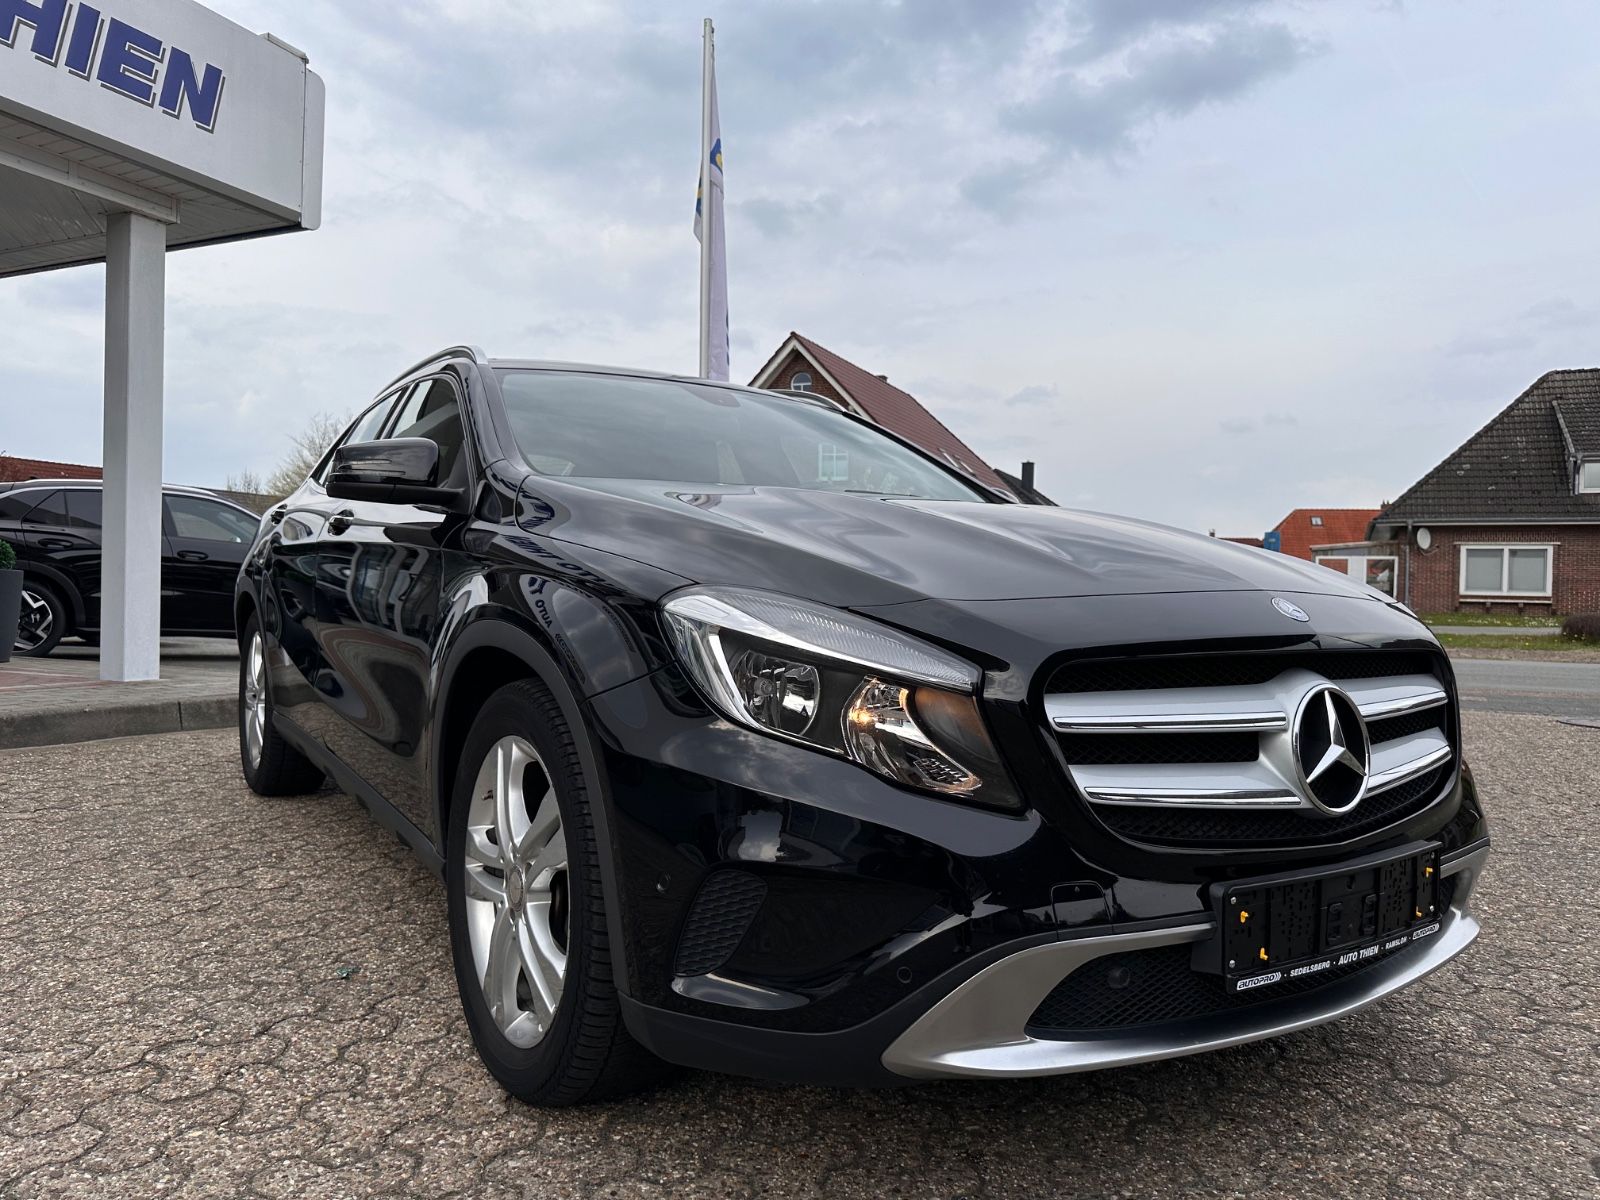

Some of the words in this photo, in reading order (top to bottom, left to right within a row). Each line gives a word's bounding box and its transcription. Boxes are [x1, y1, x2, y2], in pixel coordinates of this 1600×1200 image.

[0, 0, 225, 134] HIEN
[1289, 960, 1331, 977] SEDELSBERG
[1338, 951, 1358, 965] AUTO
[1359, 944, 1379, 959] THIEN
